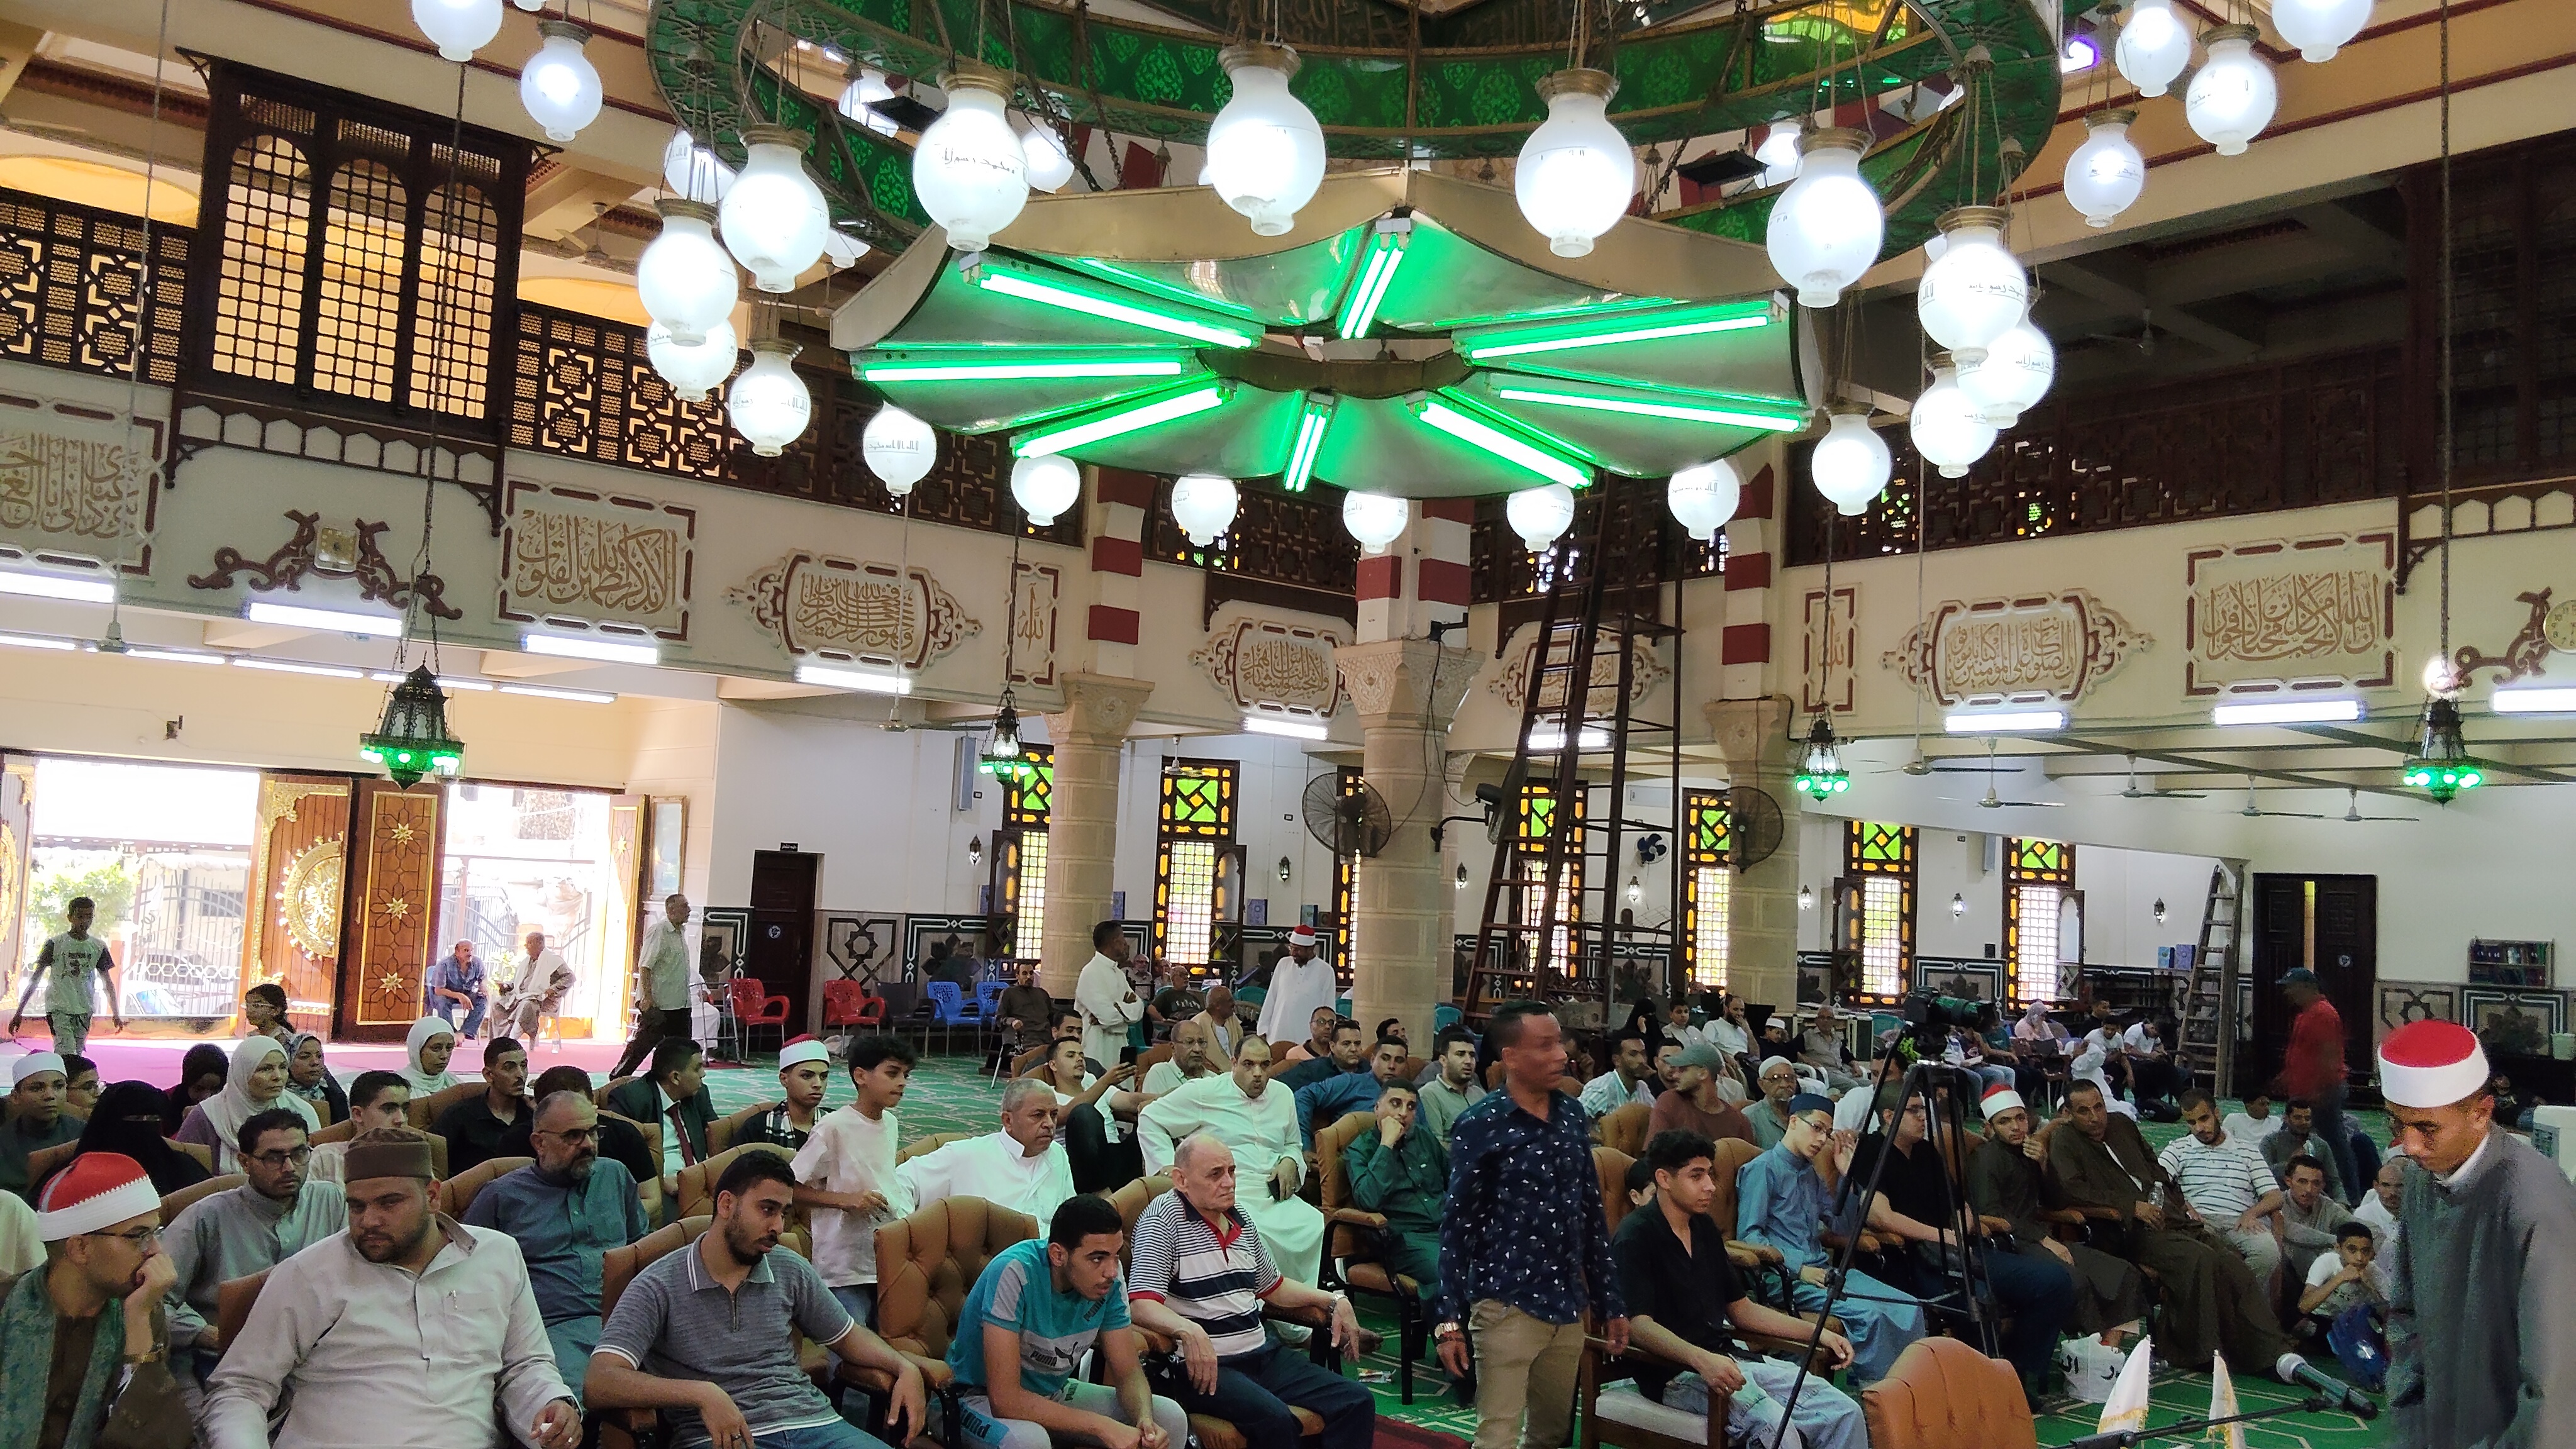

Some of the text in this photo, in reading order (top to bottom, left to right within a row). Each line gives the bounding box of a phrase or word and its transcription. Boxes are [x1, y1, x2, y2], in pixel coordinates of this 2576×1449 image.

[1017, 583, 1043, 652] الله
[1817, 613, 1844, 679] الله
[1030, 1350, 1058, 1367] PUMA
